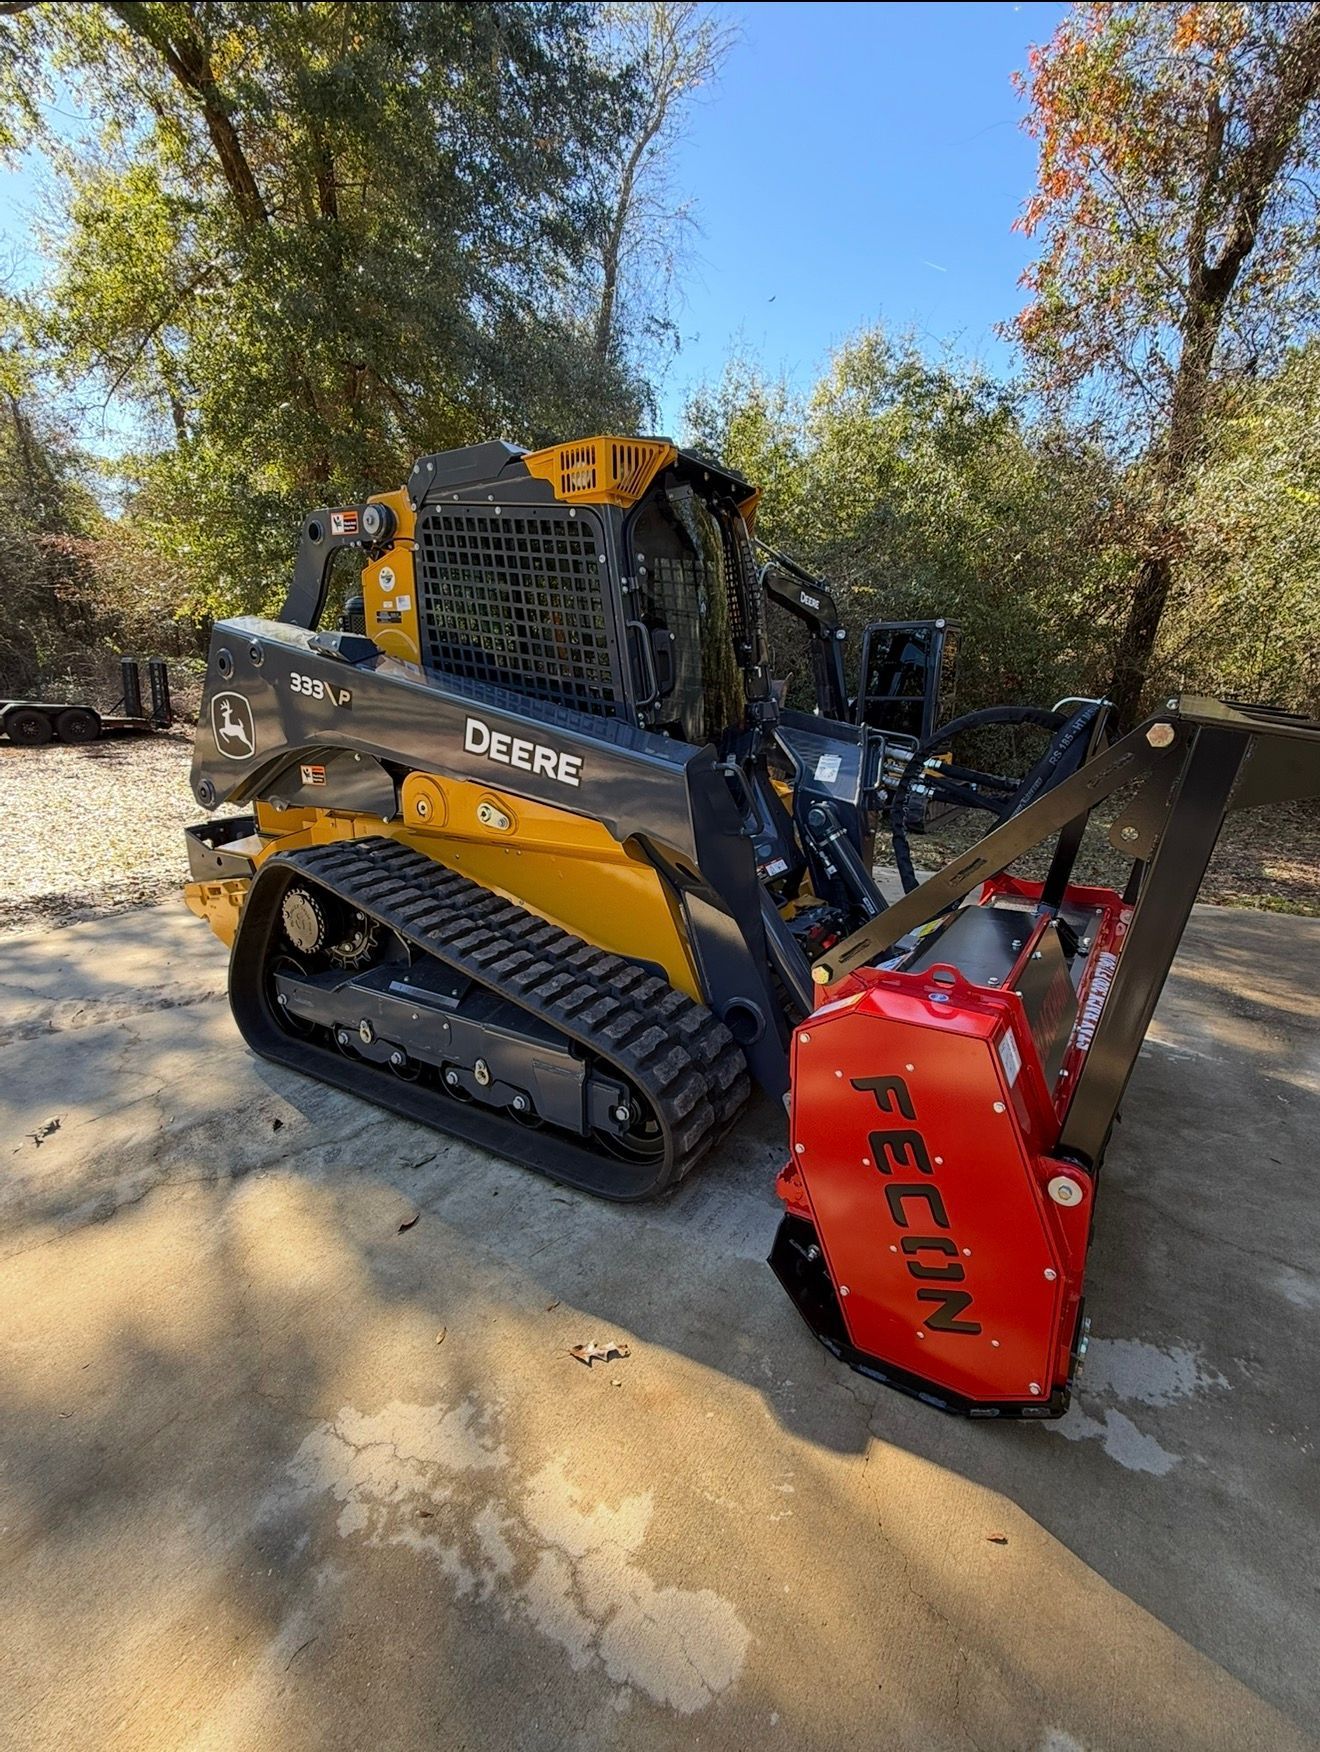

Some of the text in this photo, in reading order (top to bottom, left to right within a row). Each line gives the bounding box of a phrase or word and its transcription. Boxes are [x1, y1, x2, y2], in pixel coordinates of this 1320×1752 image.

[800, 591, 820, 610] DEERE
[465, 717, 582, 787] DEERE
[1083, 995, 1105, 1022] BACK
[1075, 1021, 1096, 1051] STAY
[849, 1075, 982, 1335] FECON
